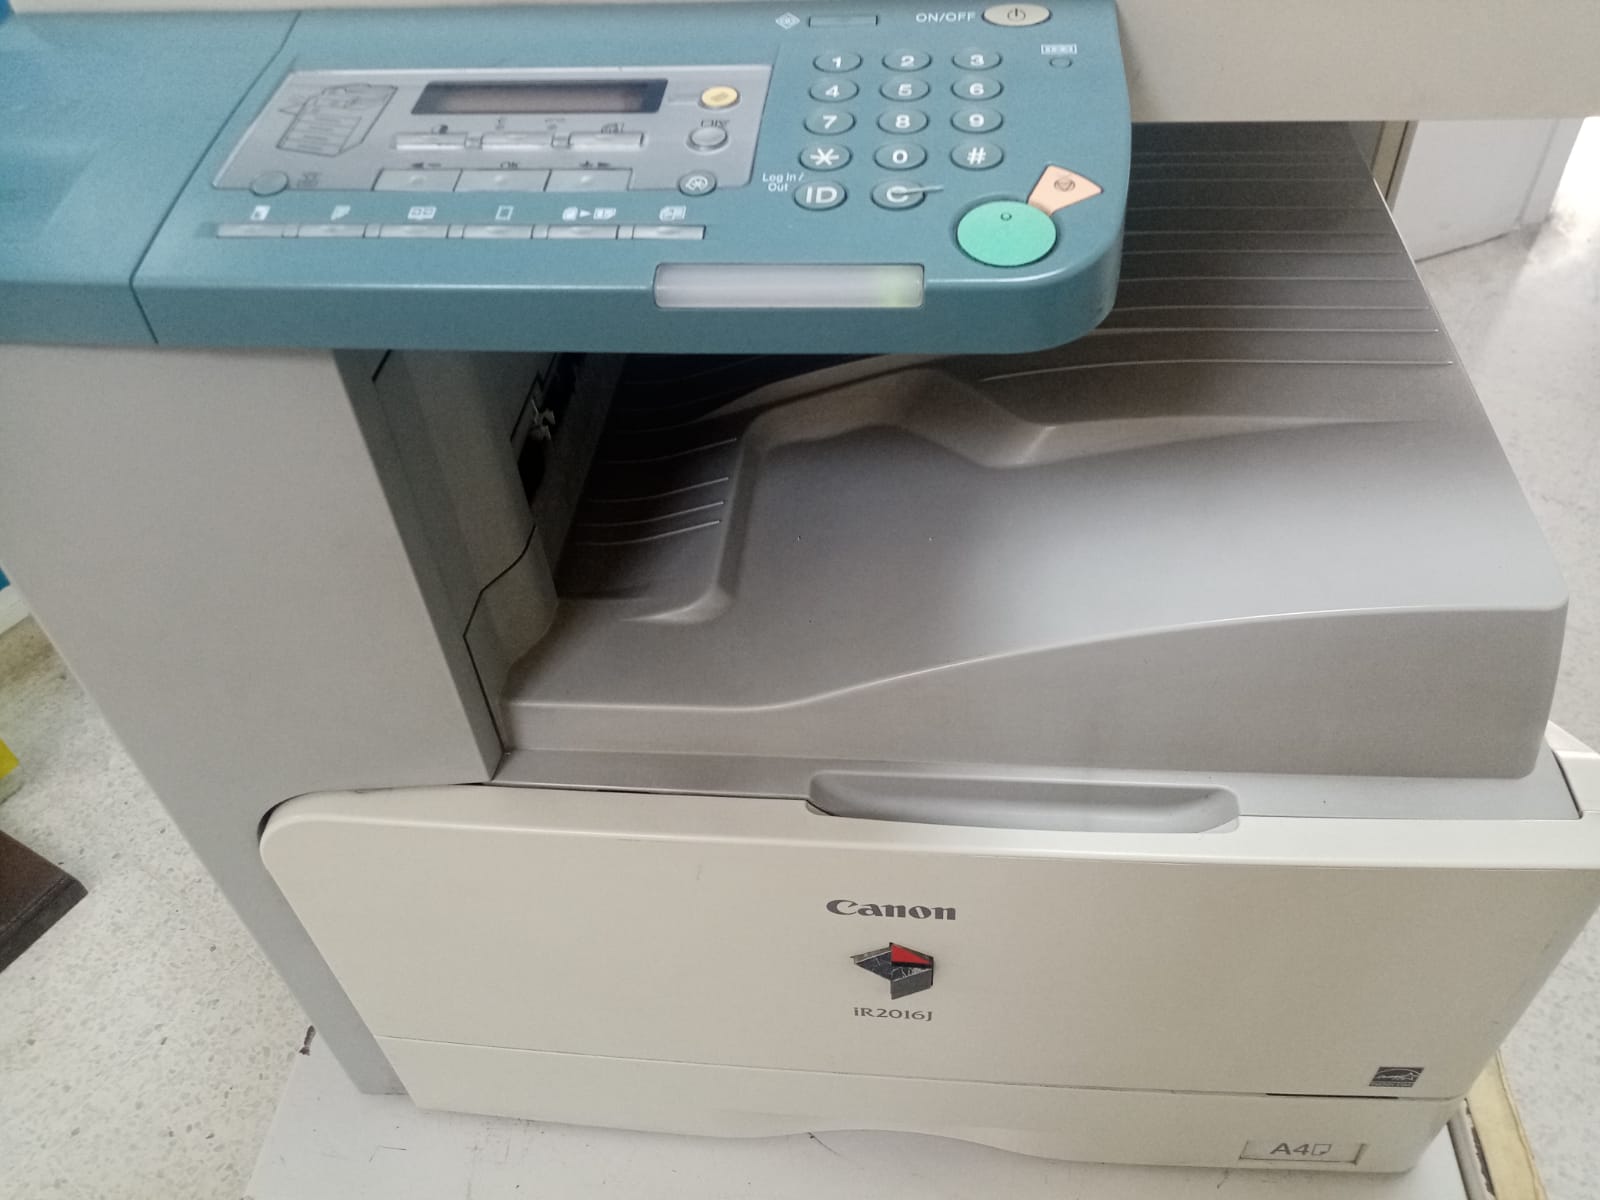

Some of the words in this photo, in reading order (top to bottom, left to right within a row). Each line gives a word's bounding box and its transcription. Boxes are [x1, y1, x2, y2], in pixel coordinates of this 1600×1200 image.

[915, 12, 975, 23] ON/OFF
[832, 56, 843, 68] 1
[901, 55, 915, 67] 2
[970, 54, 985, 66] 3
[825, 85, 839, 97] 4
[898, 83, 912, 96] 5
[969, 83, 984, 96] 6
[823, 115, 838, 129] 7
[895, 114, 910, 128] 8
[969, 113, 985, 127] 9
[892, 149, 908, 164] 0
[967, 147, 986, 165] #
[762, 173, 783, 185] Log
[785, 172, 797, 184] In
[767, 181, 789, 193] Out
[806, 186, 838, 203] ID
[826, 899, 956, 921] Canon
[854, 1007, 933, 1022] iR2016J
[1270, 1142, 1309, 1156] A4
